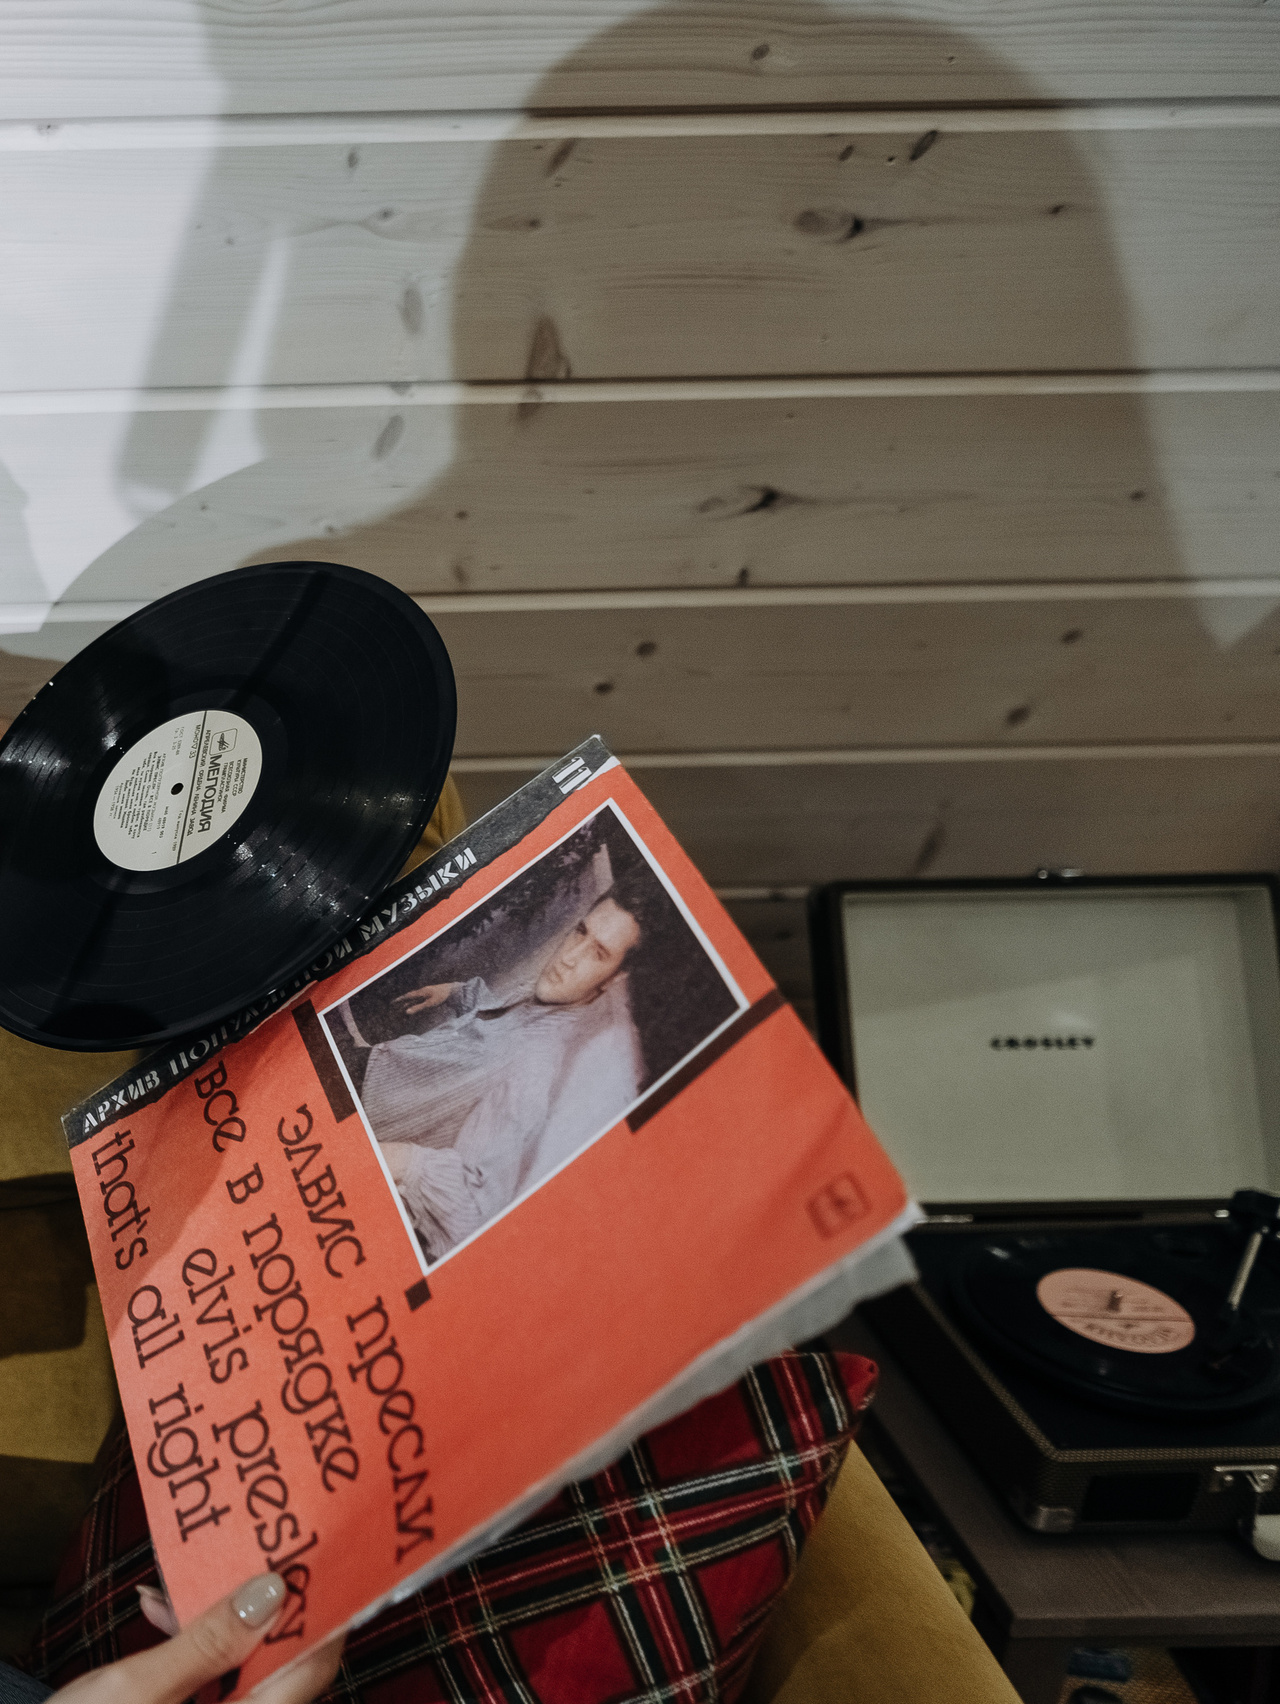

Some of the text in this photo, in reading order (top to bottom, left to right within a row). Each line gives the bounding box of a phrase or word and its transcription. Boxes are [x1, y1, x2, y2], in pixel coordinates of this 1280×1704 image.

[197, 754, 222, 833] МЕЛОДИЯ
[81, 1070, 161, 1134] АРХИВ
[359, 847, 478, 942] МУЗЫКИ
[91, 1129, 231, 1543] that's all right
[181, 1247, 253, 1385] elvis
